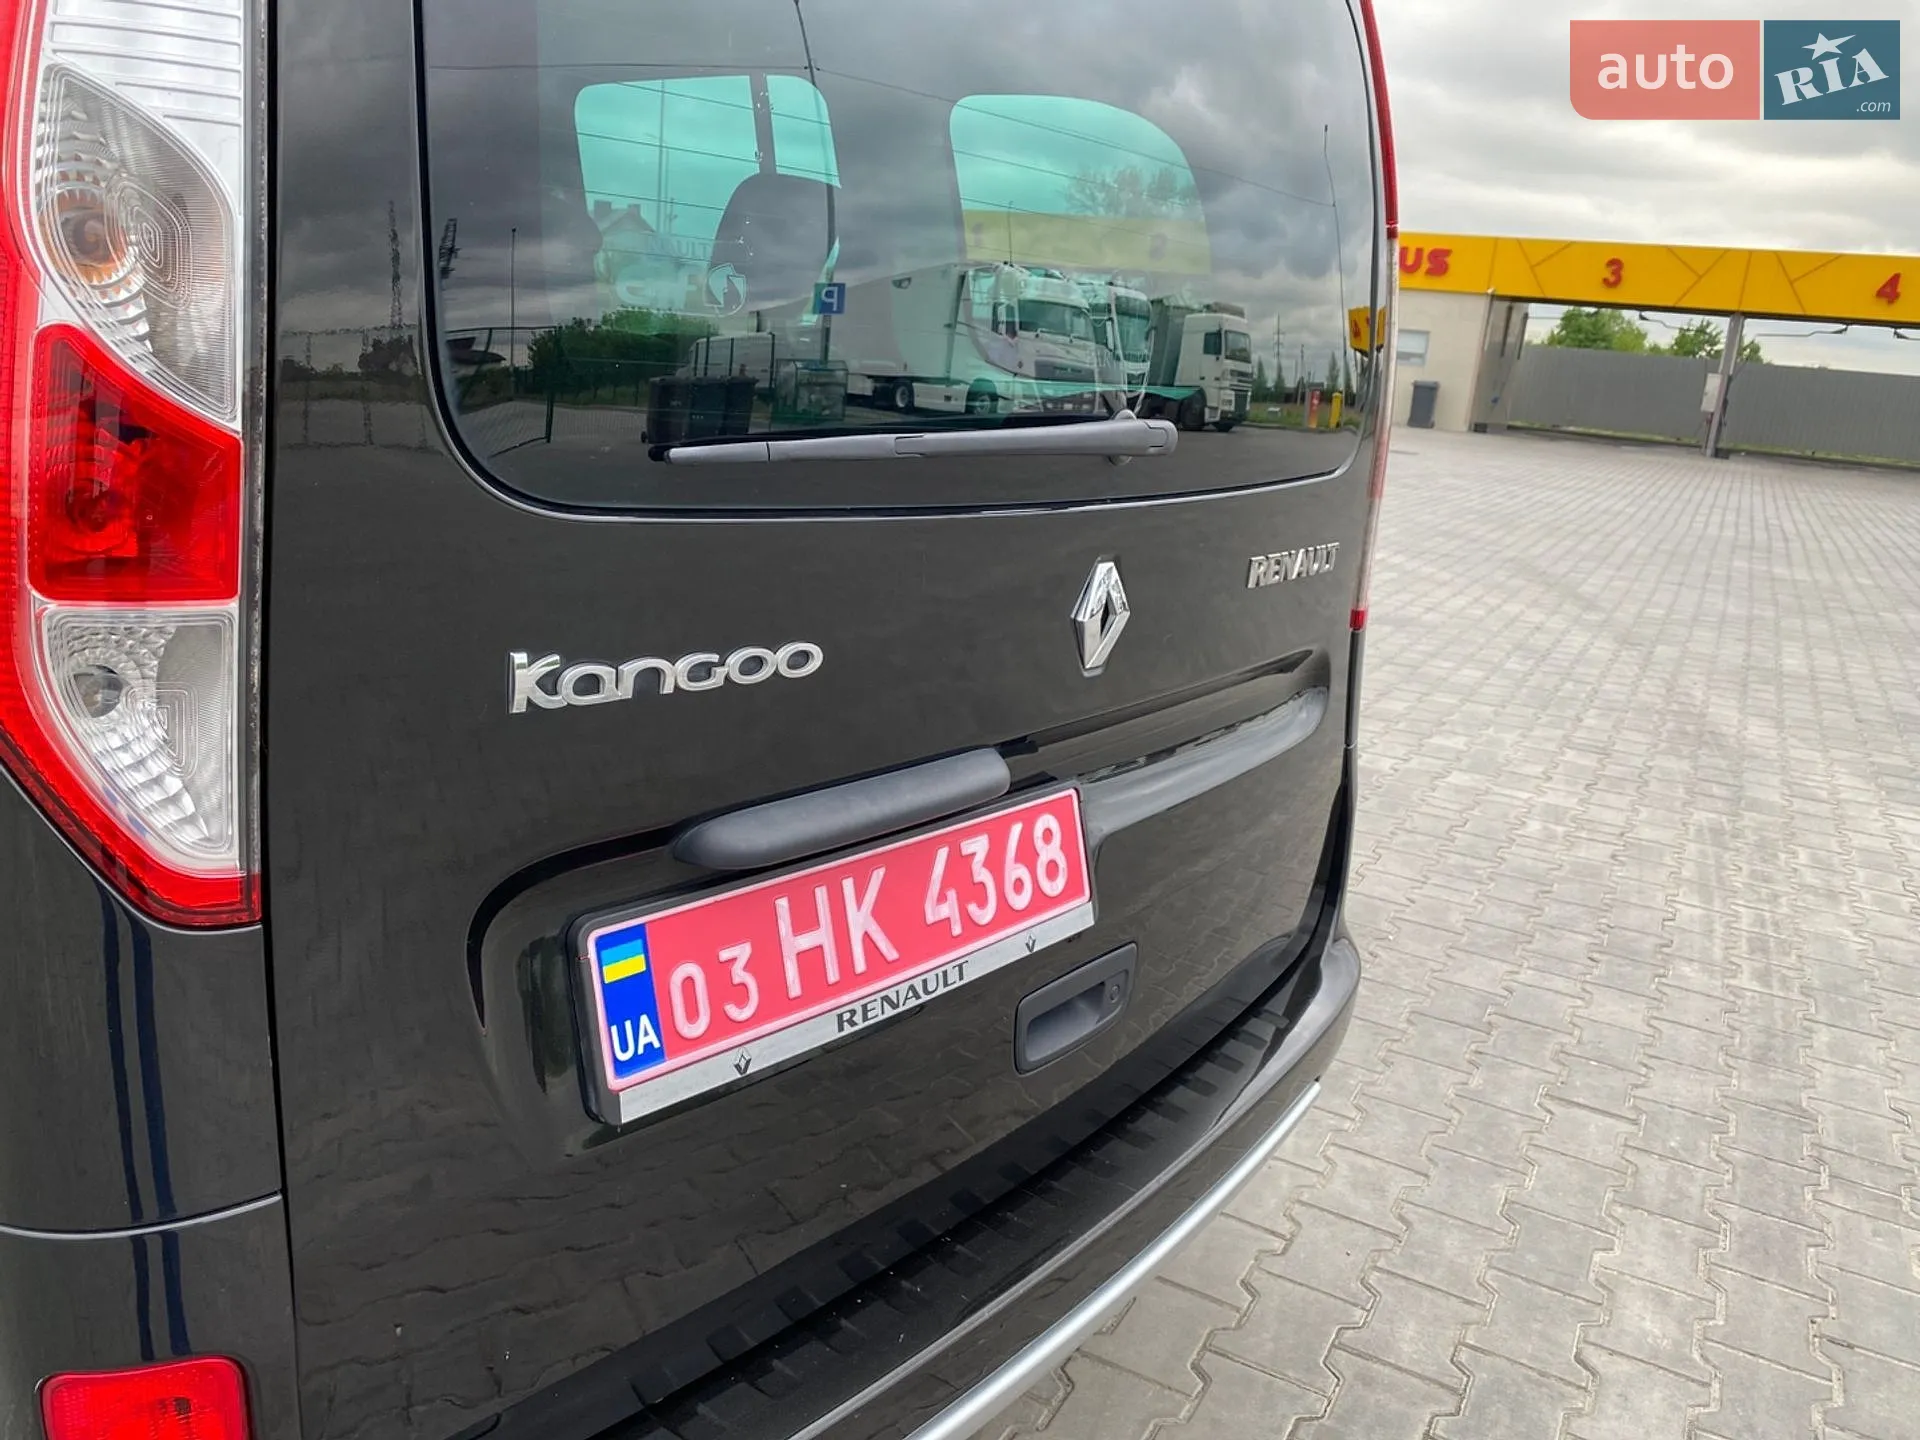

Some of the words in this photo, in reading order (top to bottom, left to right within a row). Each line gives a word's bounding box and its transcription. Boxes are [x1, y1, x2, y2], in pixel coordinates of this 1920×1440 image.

[1602, 258, 1625, 289] 3
[1875, 272, 1902, 305] 4
[1246, 542, 1340, 589] RENAULT
[508, 641, 824, 715] Kangoo
[667, 942, 760, 1041] 03
[774, 866, 900, 1000] HK
[923, 812, 1069, 938] 4368
[835, 960, 970, 1034] RENAULT
[610, 1014, 662, 1063] UA
